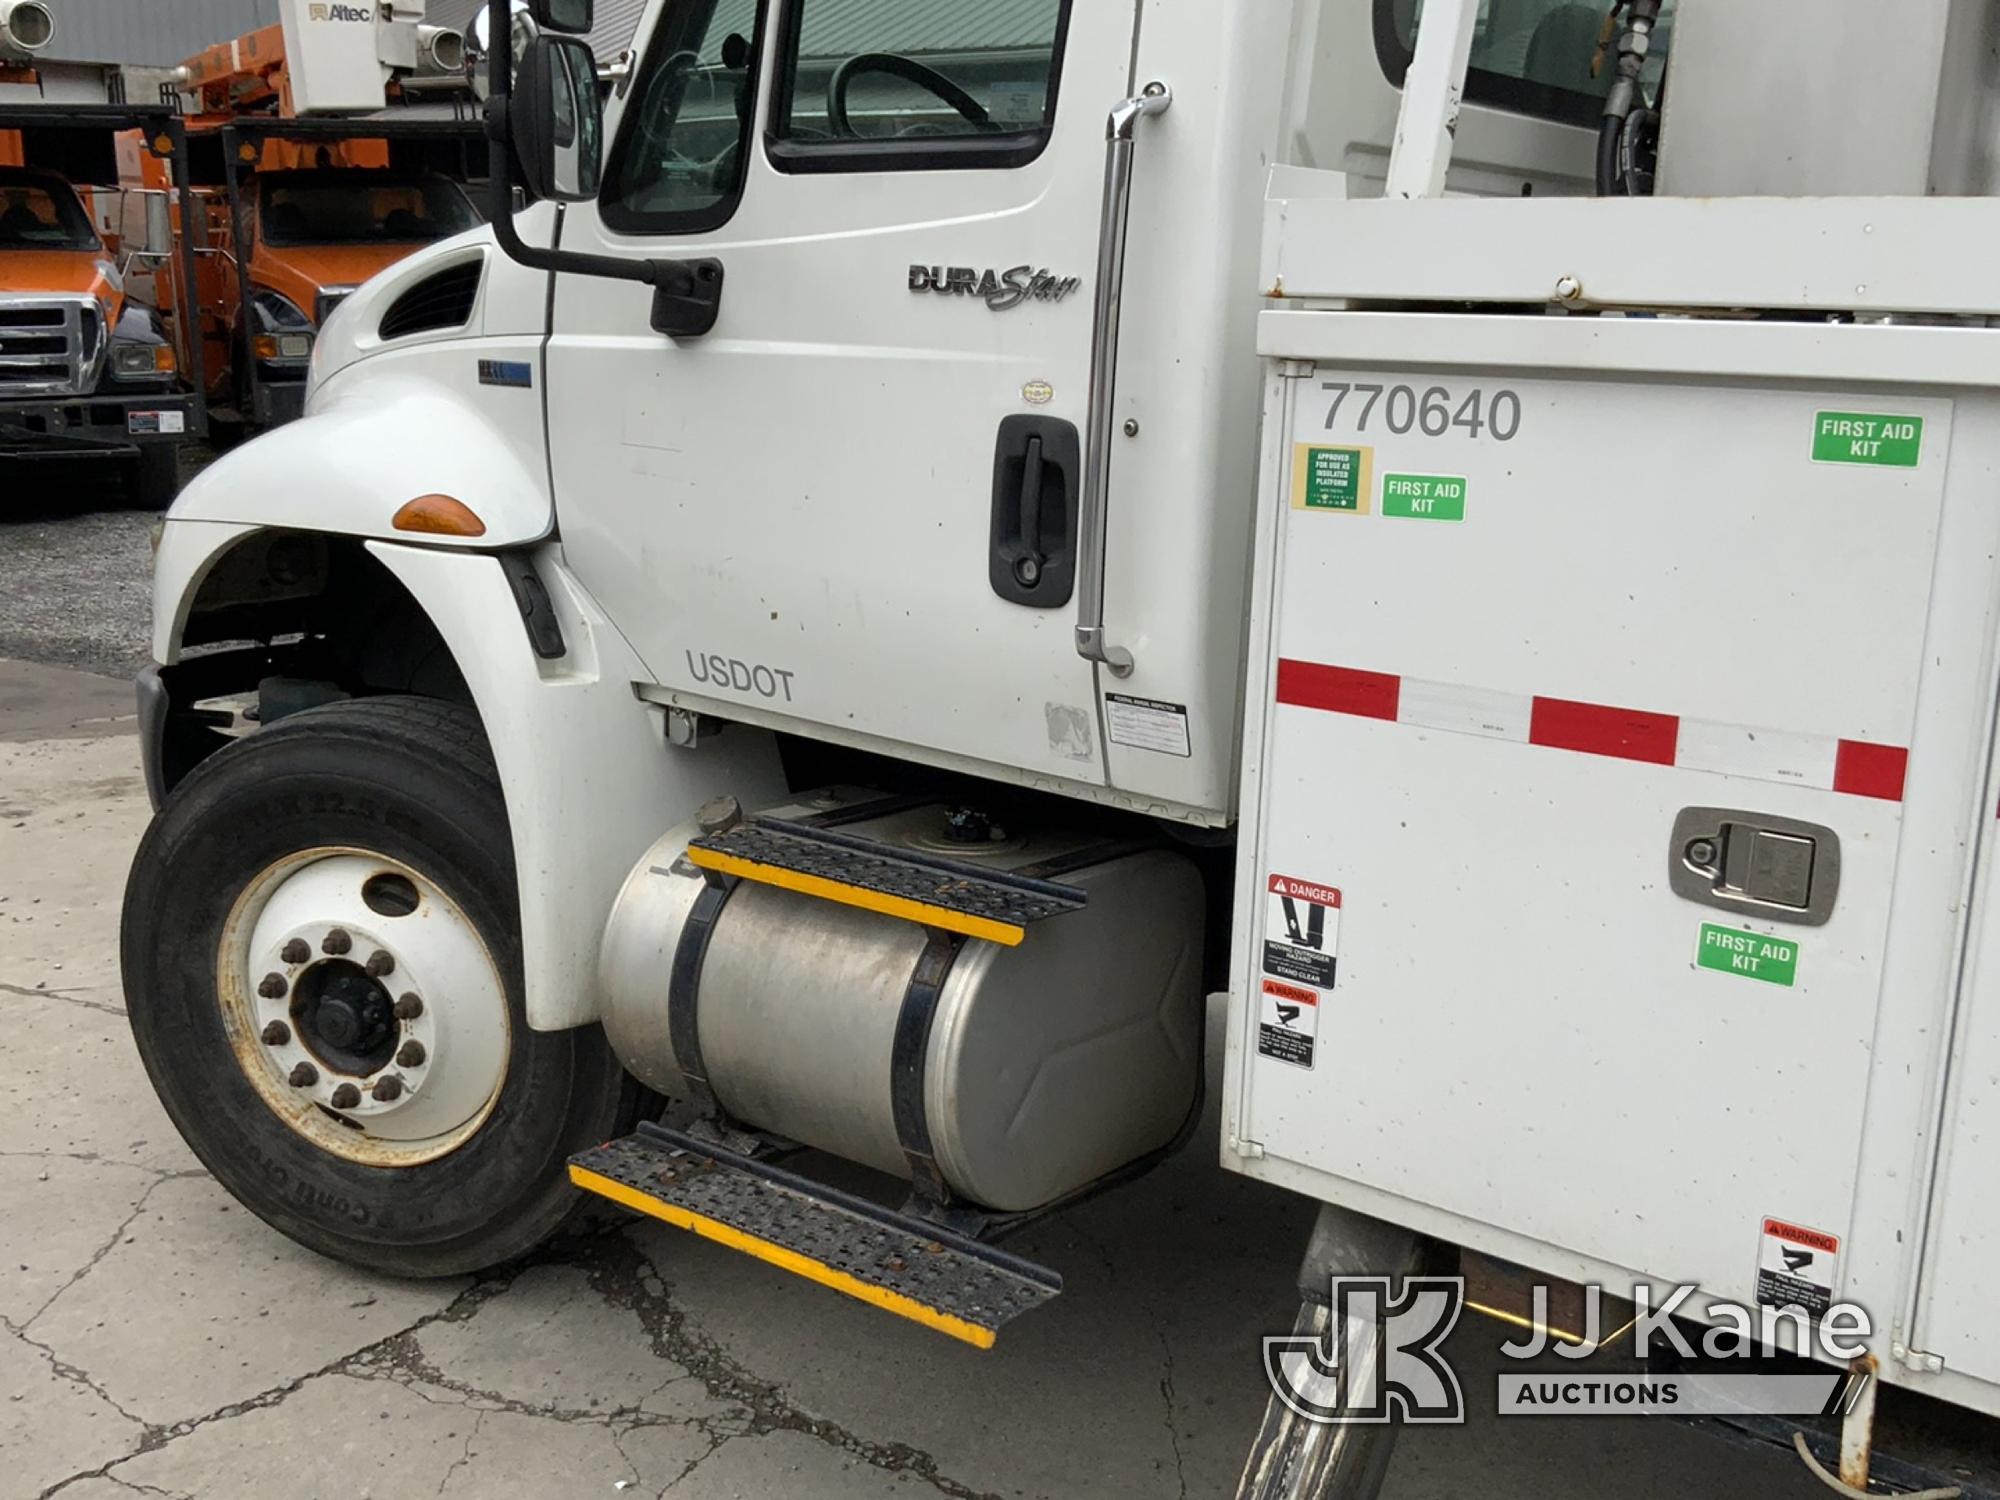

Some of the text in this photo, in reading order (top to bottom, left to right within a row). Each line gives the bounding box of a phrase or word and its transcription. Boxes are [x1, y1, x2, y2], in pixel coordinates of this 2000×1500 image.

[329, 4, 370, 22] Altec
[1322, 382, 1521, 441] 770640
[1822, 419, 1914, 440] FIRST AID
[1850, 439, 1882, 457] KIT
[1388, 480, 1460, 499] FIRST AID
[1411, 498, 1435, 513] KIT
[686, 649, 794, 702] USDOT
[1290, 883, 1335, 904] DANGER
[1706, 931, 1791, 962] FIRST AID
[1732, 953, 1760, 972] KIT
[1277, 966, 1298, 977] STAND
[1298, 970, 1320, 982] CLEAR
[1781, 1226, 1832, 1249] WARNING
